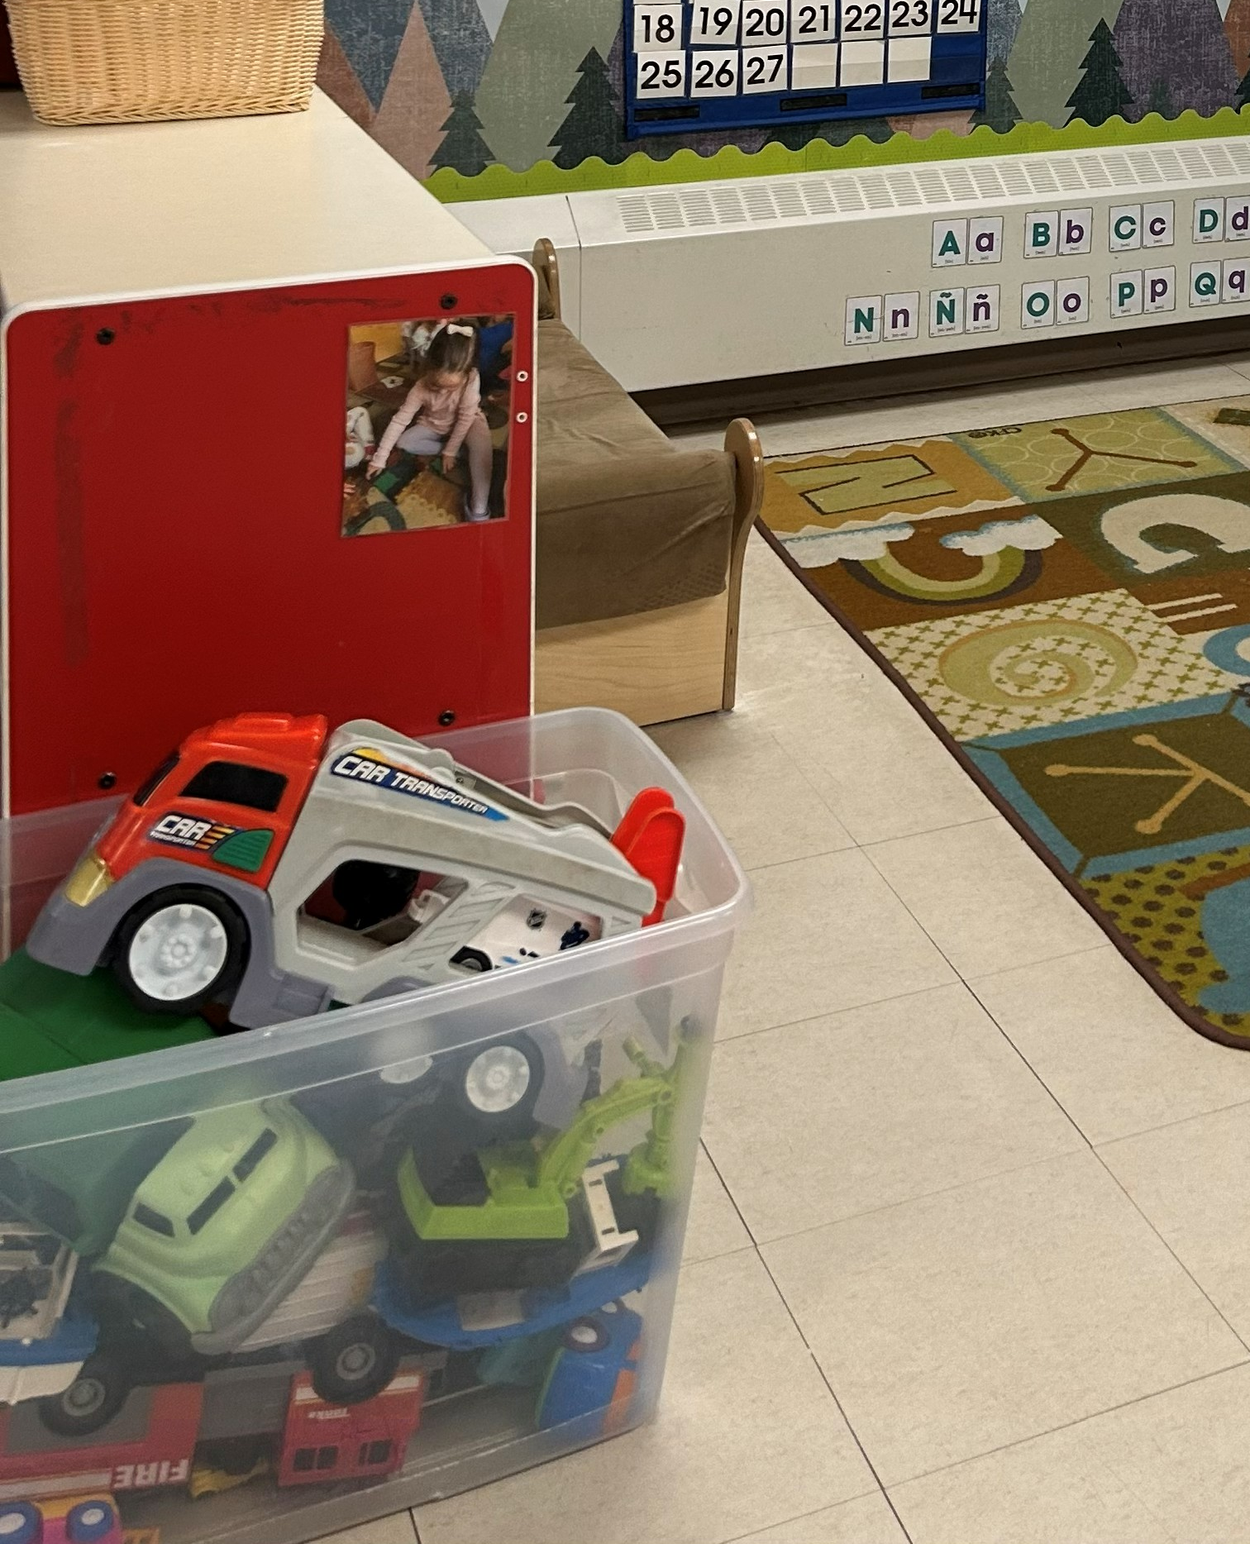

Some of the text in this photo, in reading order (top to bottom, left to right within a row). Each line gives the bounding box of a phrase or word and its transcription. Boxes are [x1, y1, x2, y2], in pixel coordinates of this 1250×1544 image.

[642, 14, 675, 43] 18
[700, 6, 733, 35] 19
[745, 8, 784, 37] 20
[798, 5, 830, 33] 21
[844, 3, 881, 32] 22
[892, 0, 929, 28] 23
[640, 54, 784, 89] 25 26 27
[334, 755, 488, 814] CAR TRANSPORTER
[153, 814, 213, 841] CAR
[114, 1458, 190, 1490] FIRE
